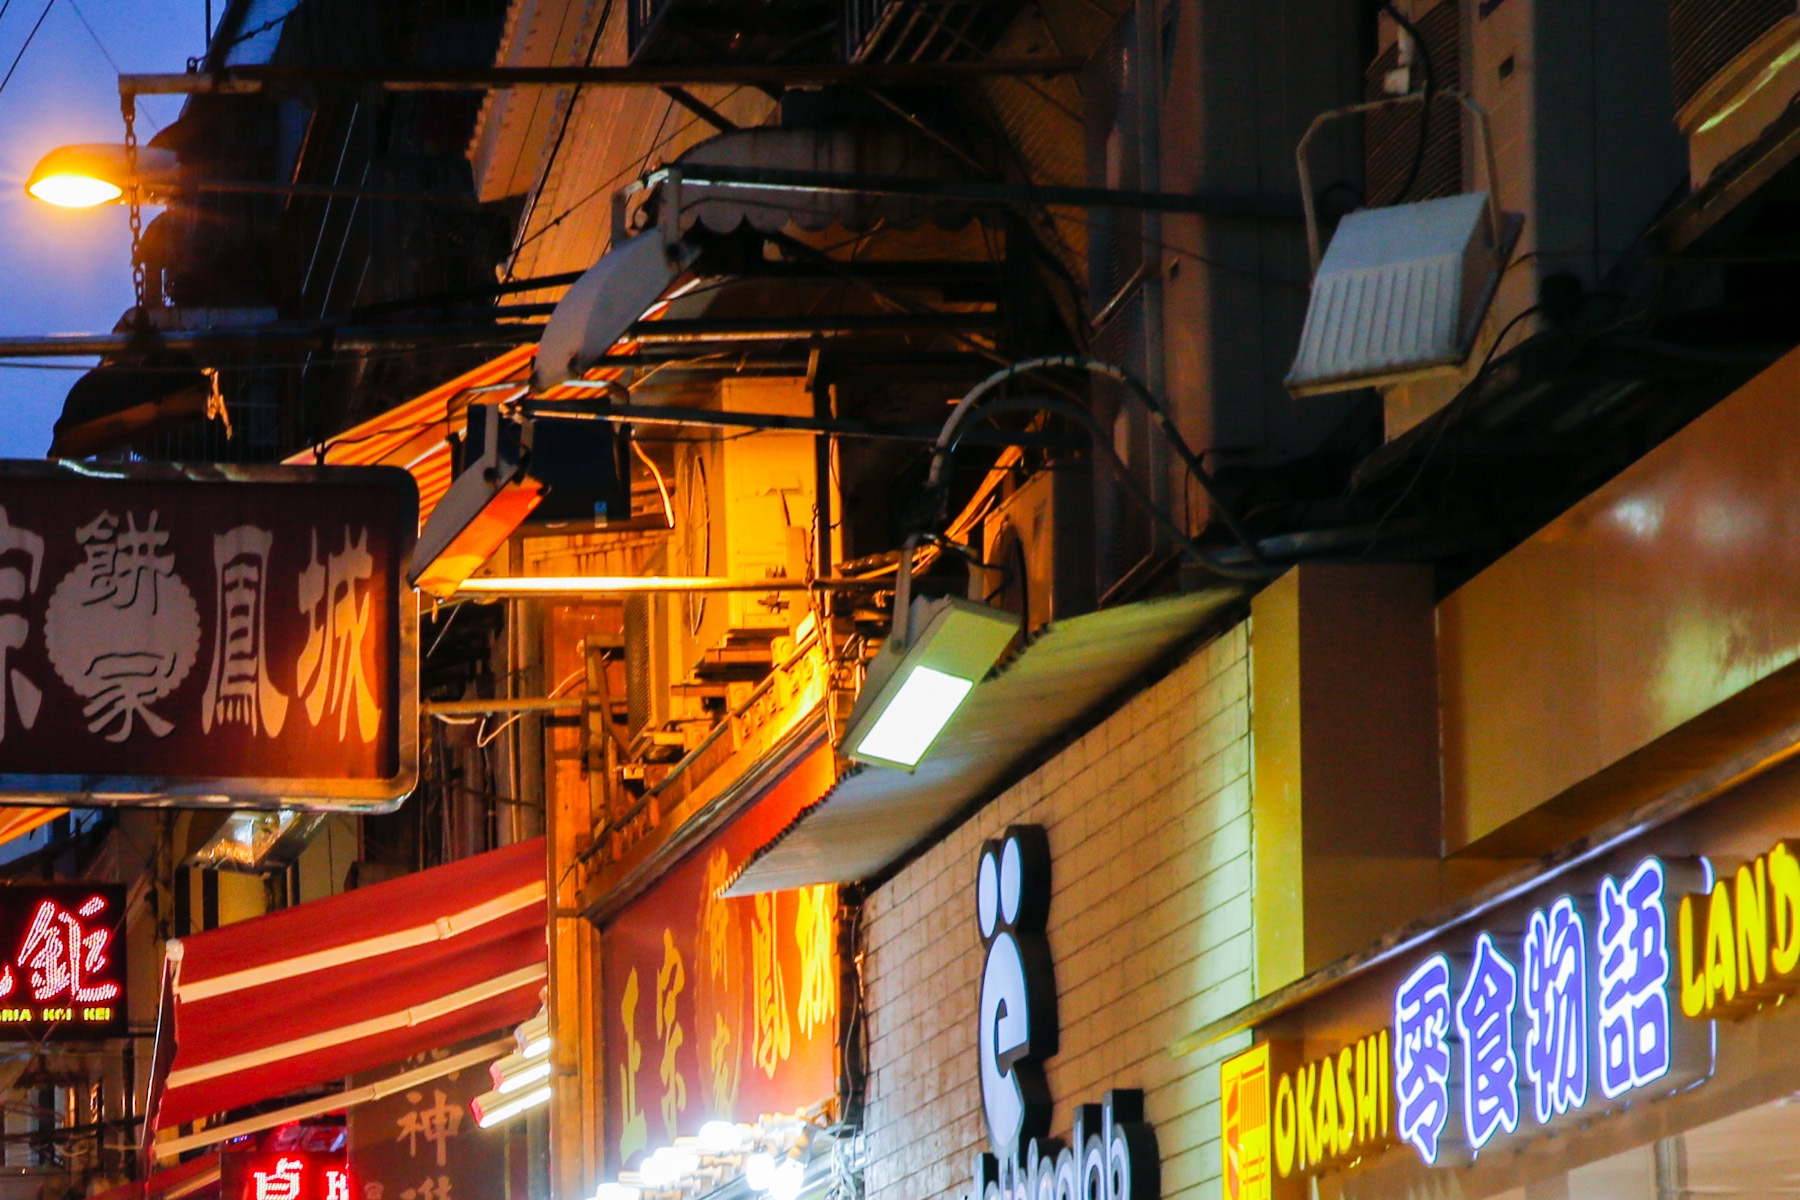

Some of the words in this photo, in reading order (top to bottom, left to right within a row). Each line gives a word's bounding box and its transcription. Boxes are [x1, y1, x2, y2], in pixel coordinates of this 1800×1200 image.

[1393, 856, 1671, 1165] 零食物語
[1678, 839, 1800, 1018] LAND
[83, 1006, 112, 1021] KEI
[1275, 1028, 1389, 1178] OKASHI
